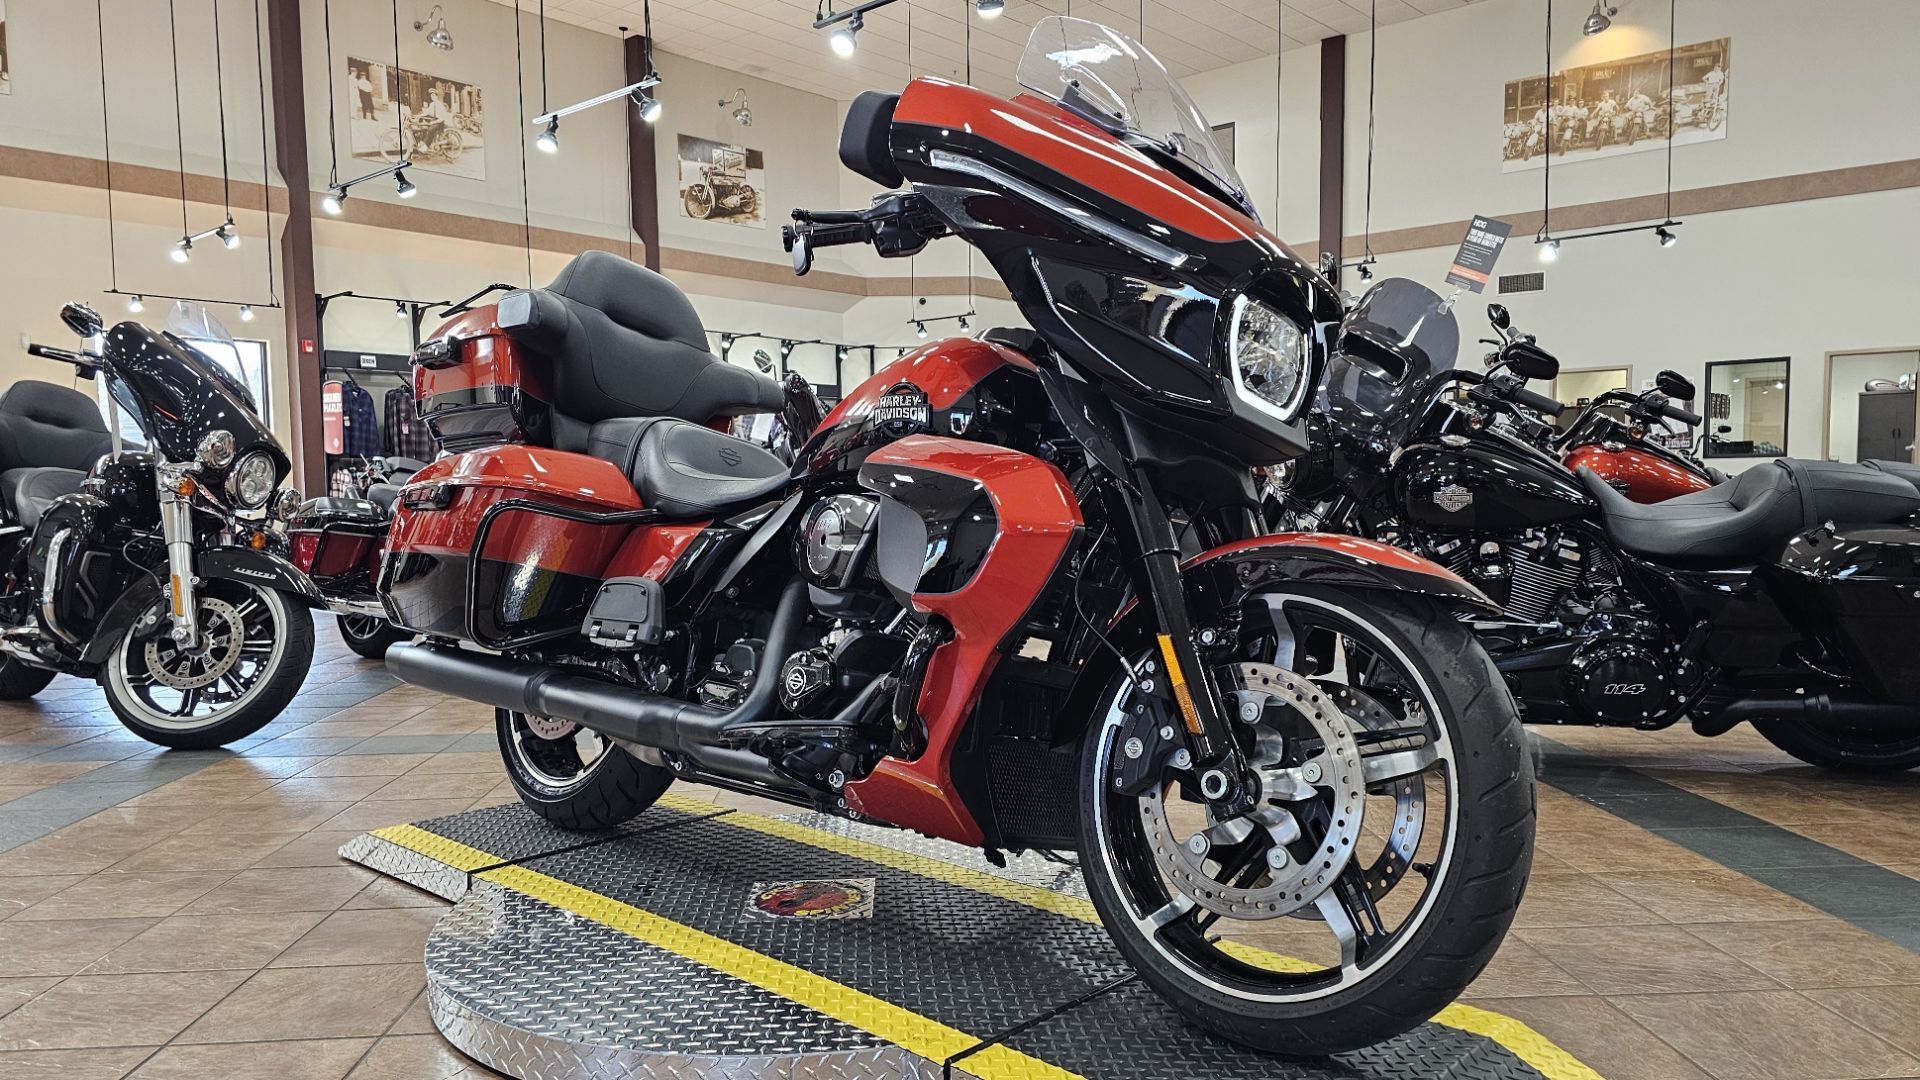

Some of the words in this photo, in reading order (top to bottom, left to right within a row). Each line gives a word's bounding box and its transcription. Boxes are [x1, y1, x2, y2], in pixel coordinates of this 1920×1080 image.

[880, 395, 922, 408] HARLEY-
[874, 406, 927, 425] DAVIDSON
[1603, 683, 1647, 695] 114
